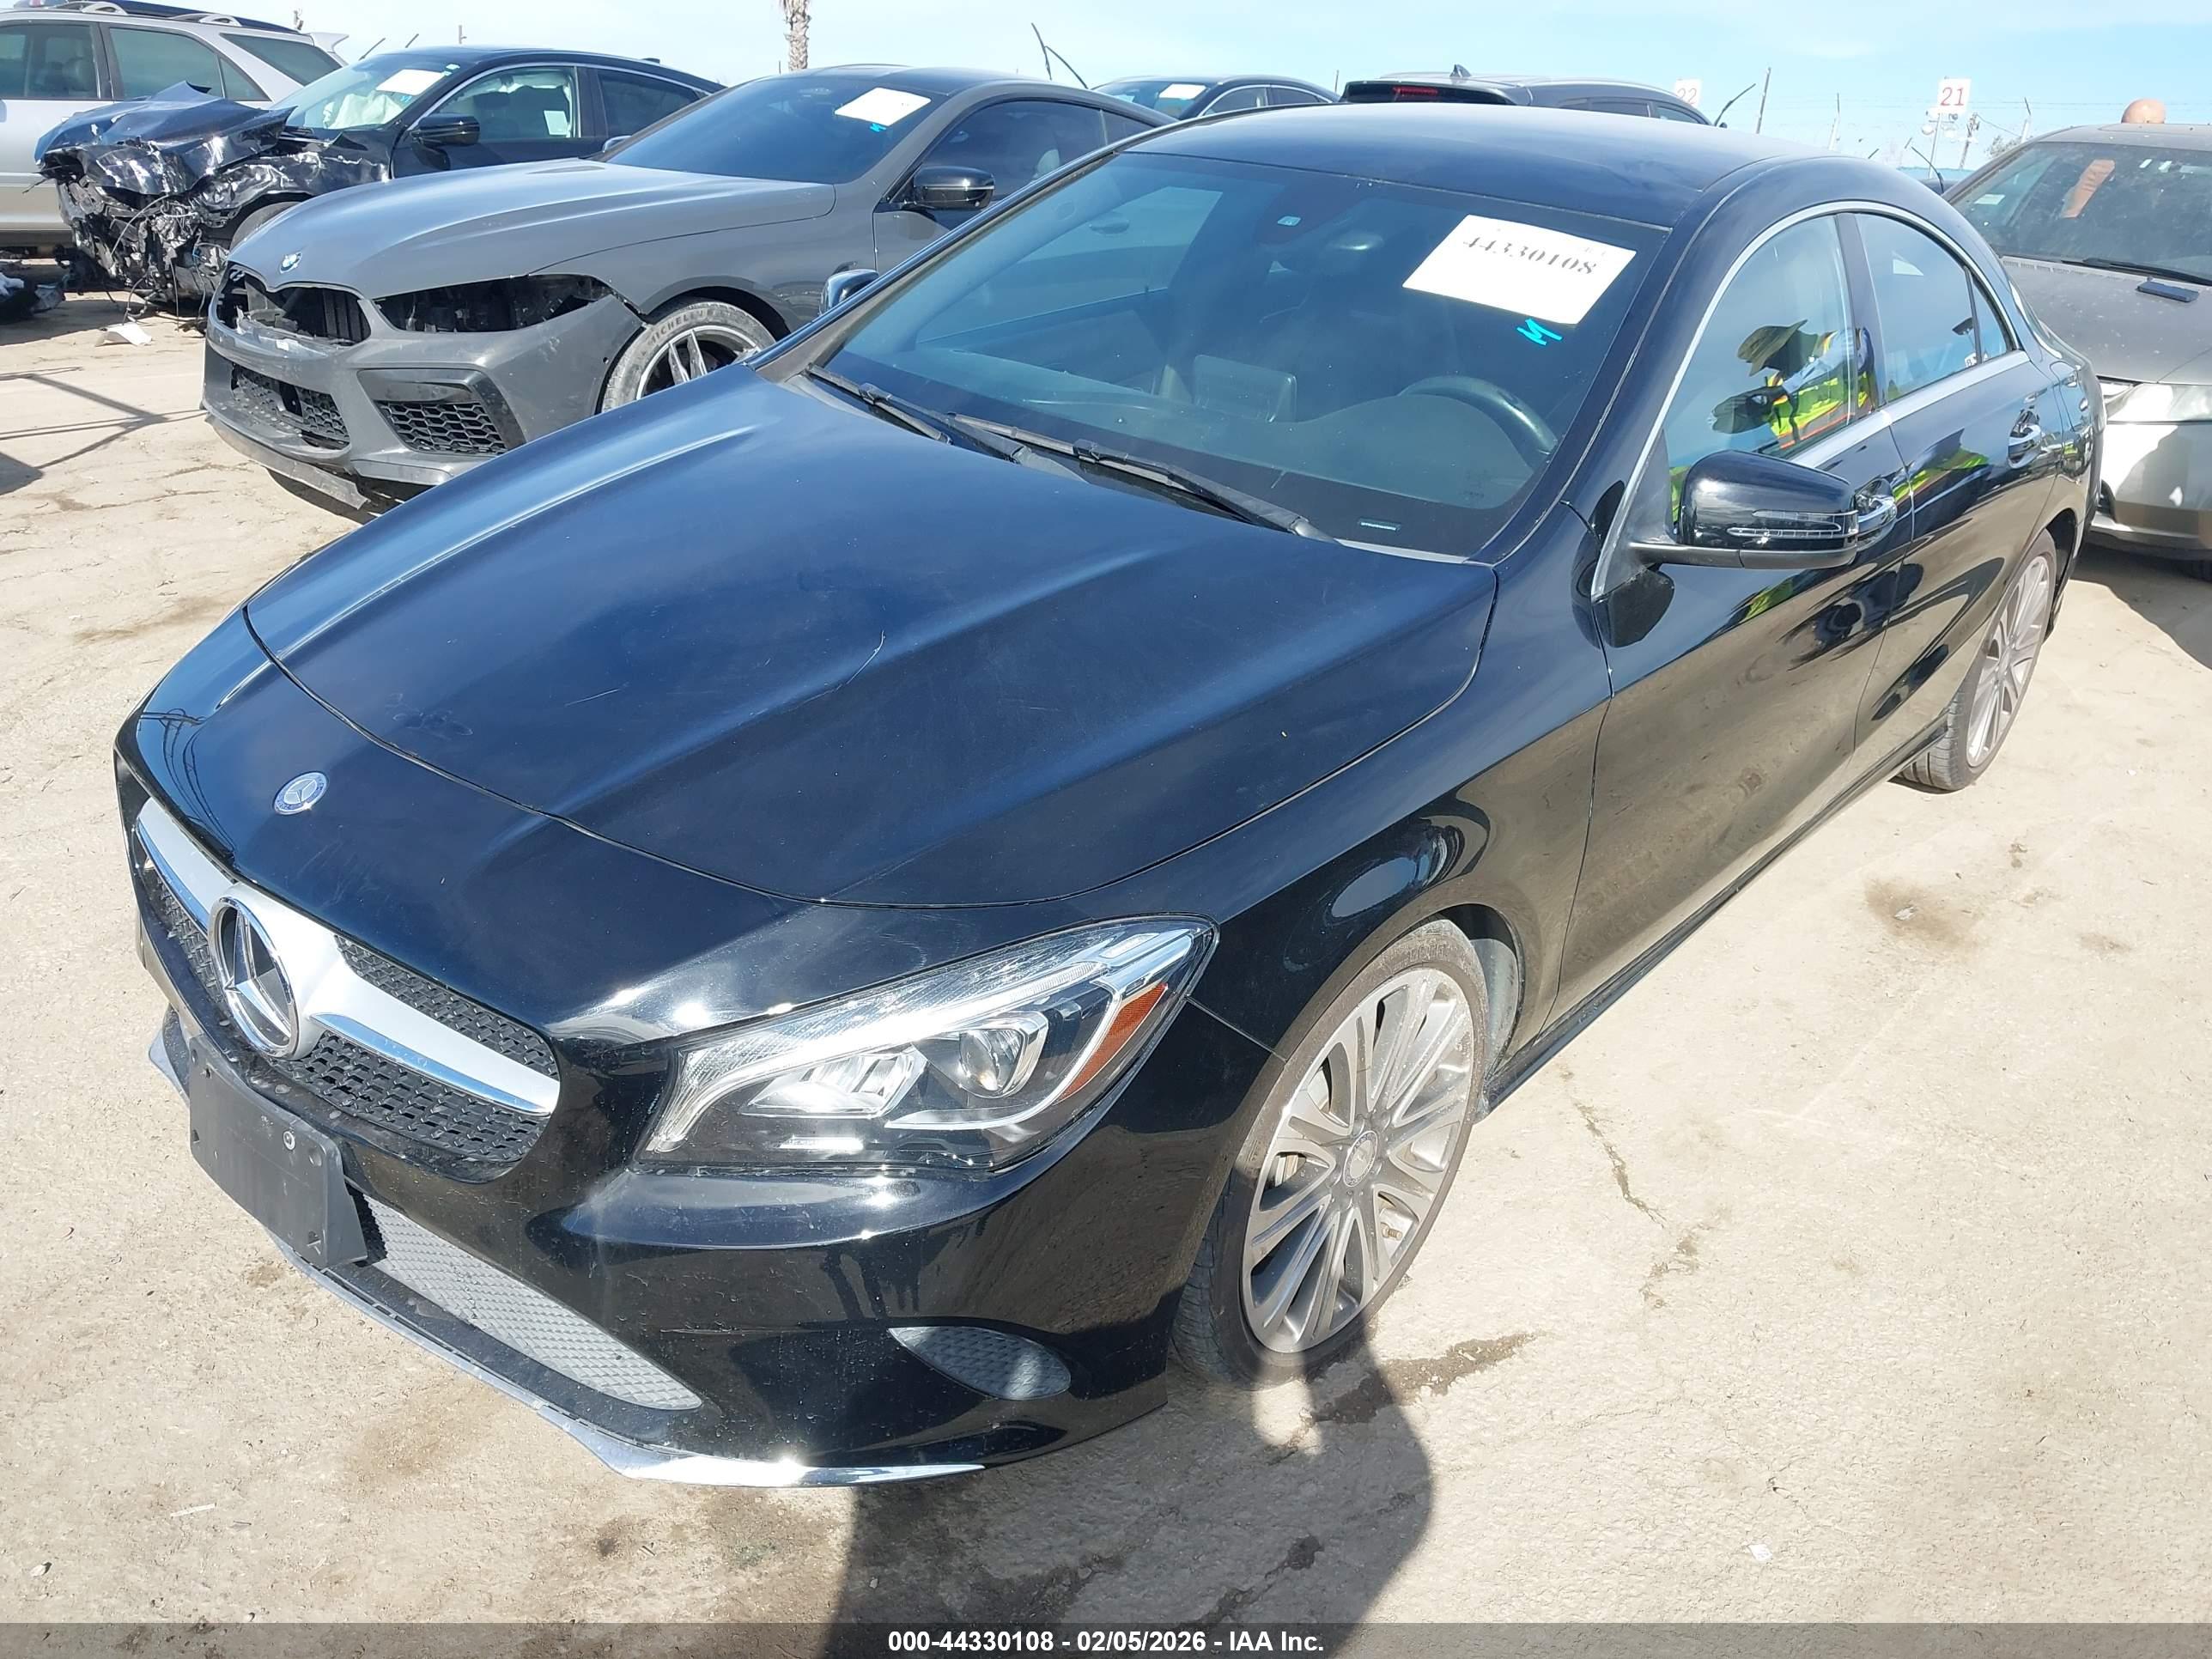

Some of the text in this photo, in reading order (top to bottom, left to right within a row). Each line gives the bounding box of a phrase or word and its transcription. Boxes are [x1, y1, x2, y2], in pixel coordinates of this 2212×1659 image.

[1677, 88, 1697, 104] 22
[1941, 87, 1964, 106] 21
[1462, 237, 1596, 274] 44330108
